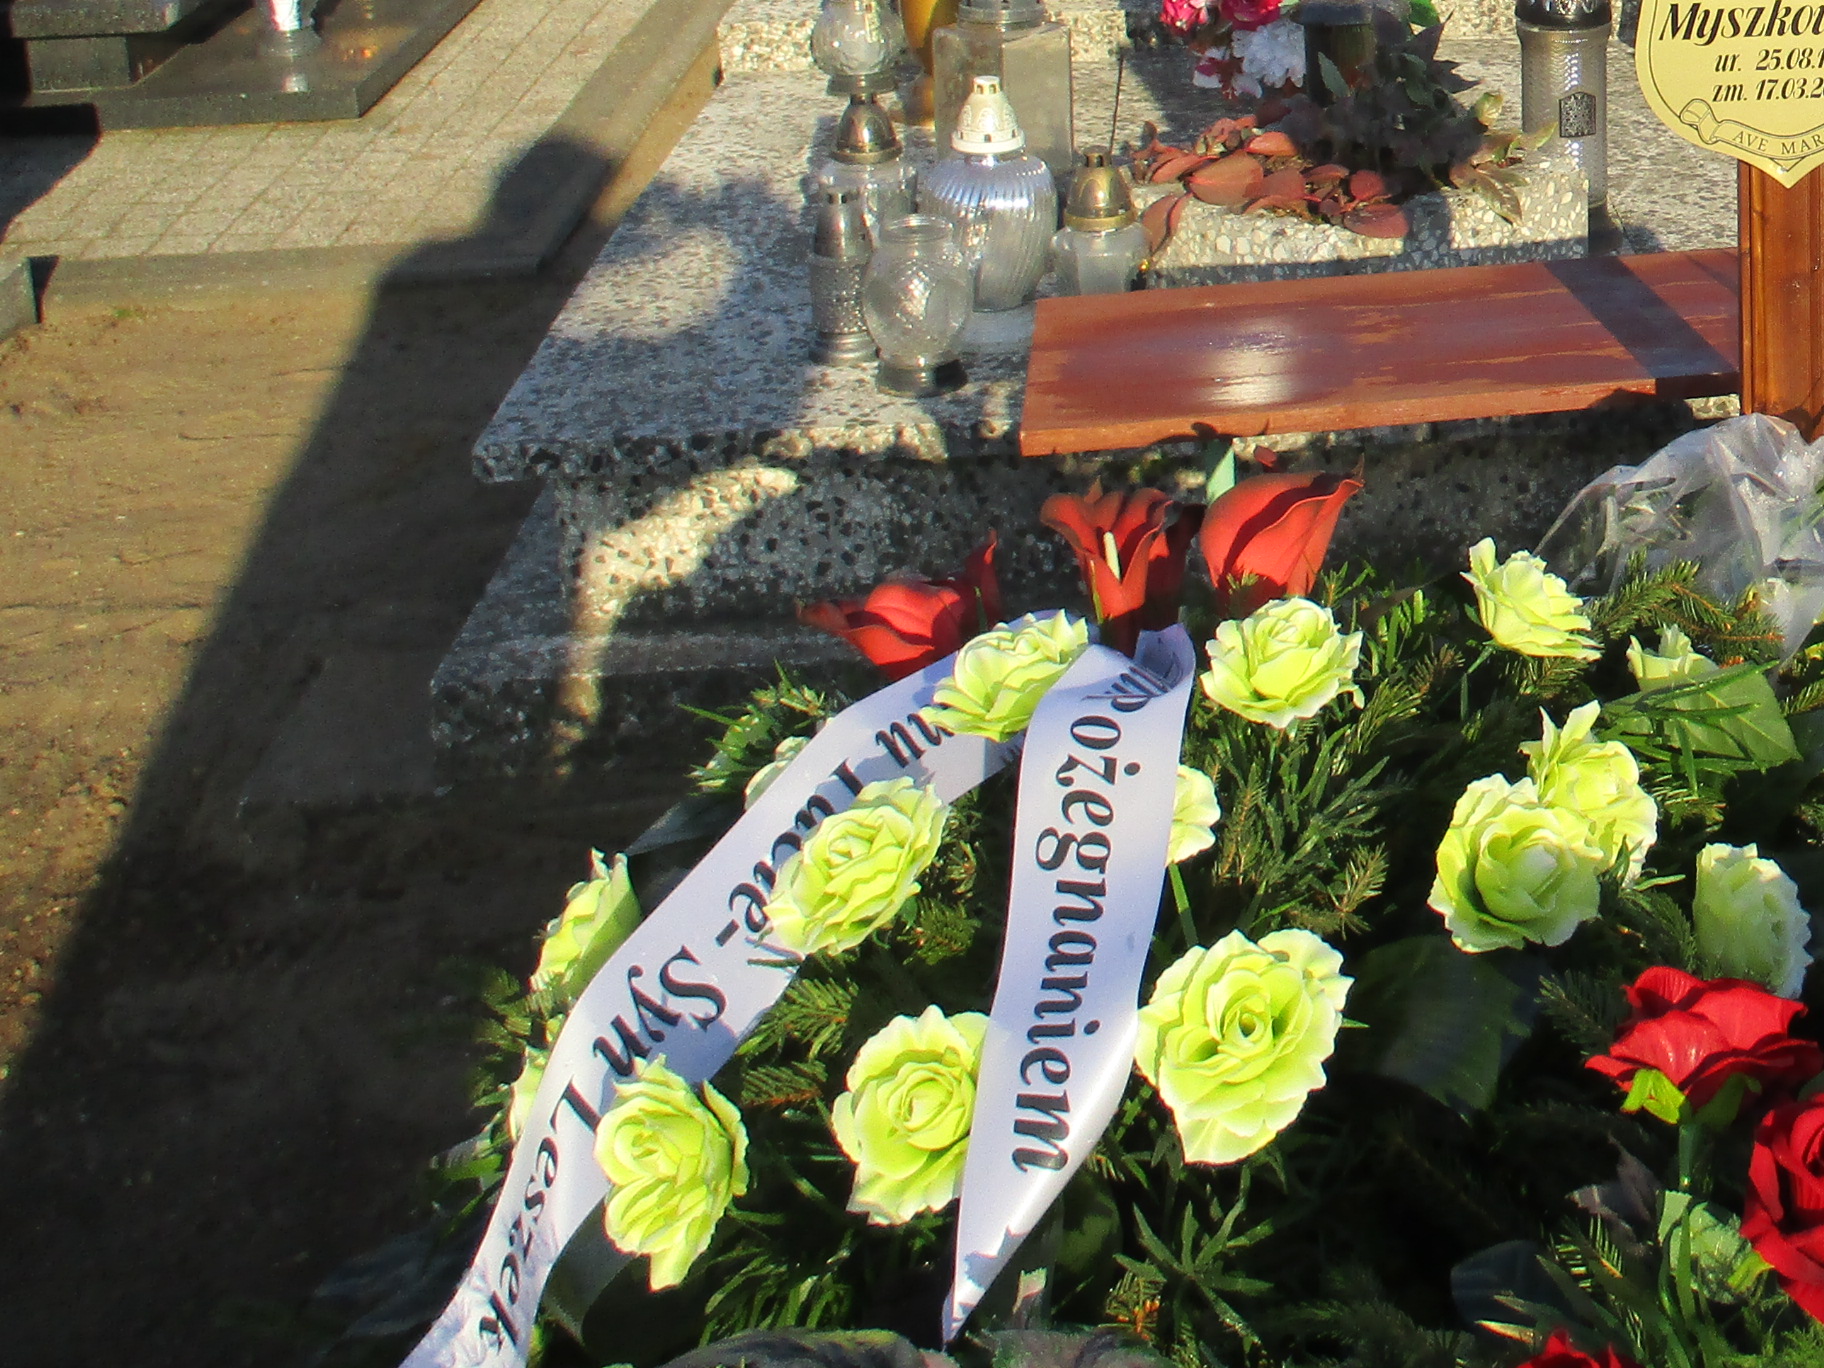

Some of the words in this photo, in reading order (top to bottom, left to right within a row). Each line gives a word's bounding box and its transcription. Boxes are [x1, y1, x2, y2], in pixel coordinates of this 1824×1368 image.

[1714, 52, 1742, 72] ur.
[1711, 84, 1748, 102] zm.
[1732, 130, 1767, 152] AVE
[590, 944, 729, 1077] Syn
[479, 1074, 602, 1354] Leszek
